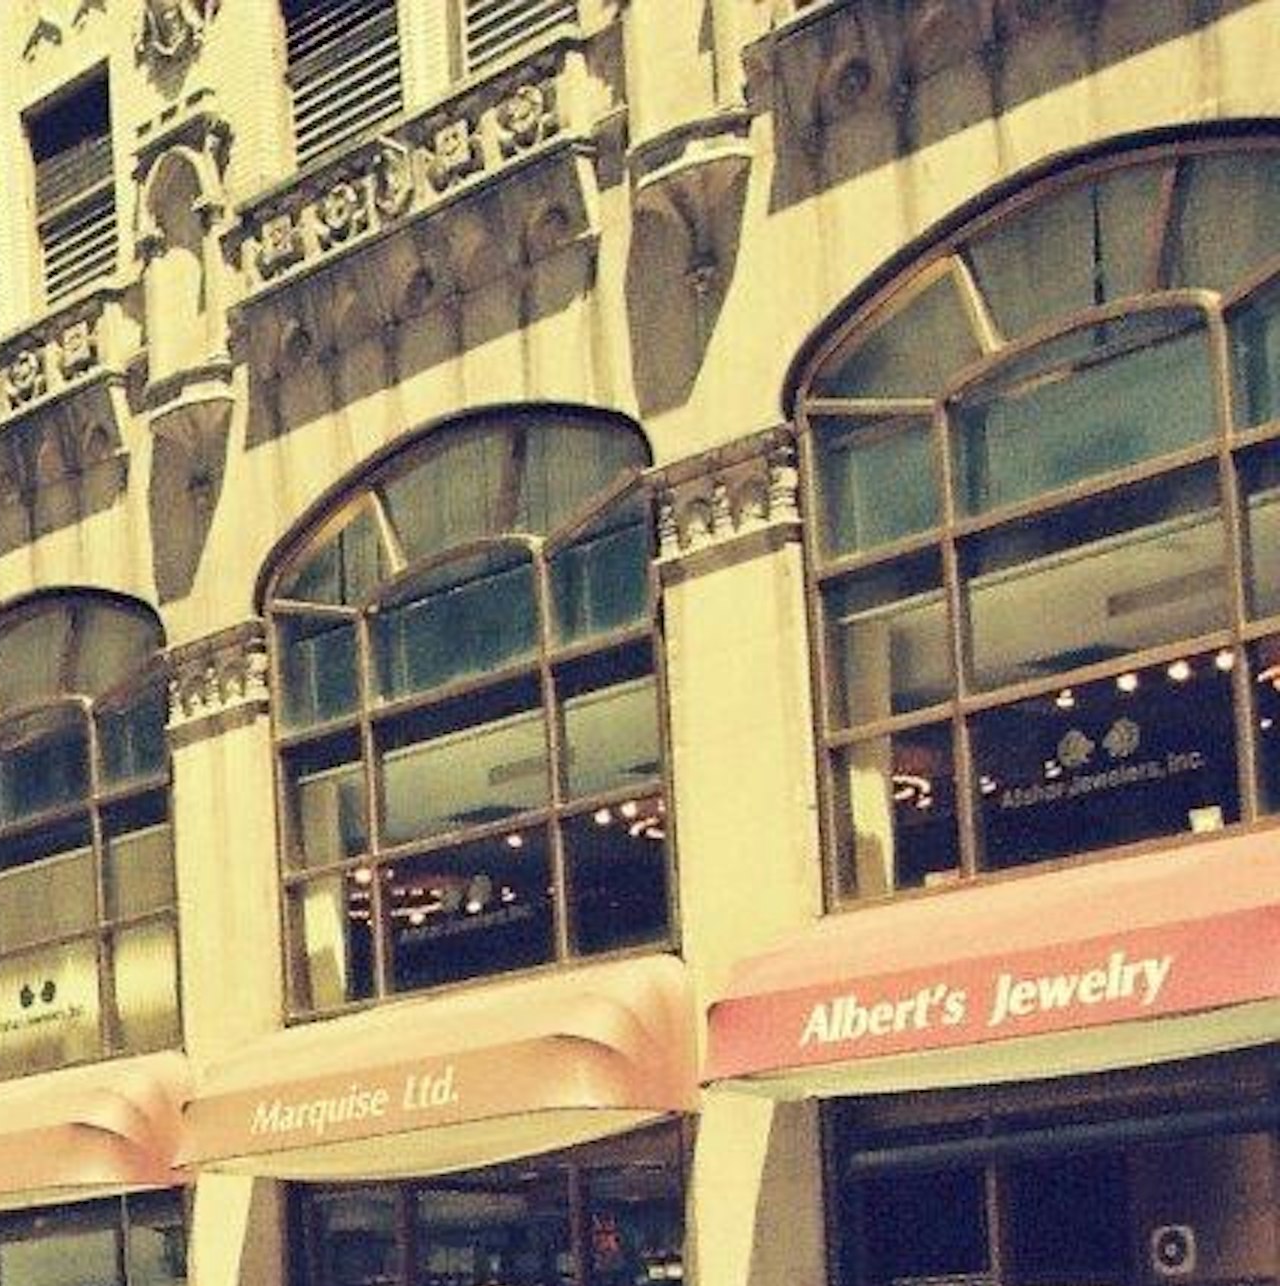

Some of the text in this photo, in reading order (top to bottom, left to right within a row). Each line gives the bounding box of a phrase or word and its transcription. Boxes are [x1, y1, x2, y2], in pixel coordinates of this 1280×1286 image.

[799, 949, 1172, 1047] Albert's Jewelry
[250, 1064, 460, 1138] Marquise Ltd.
